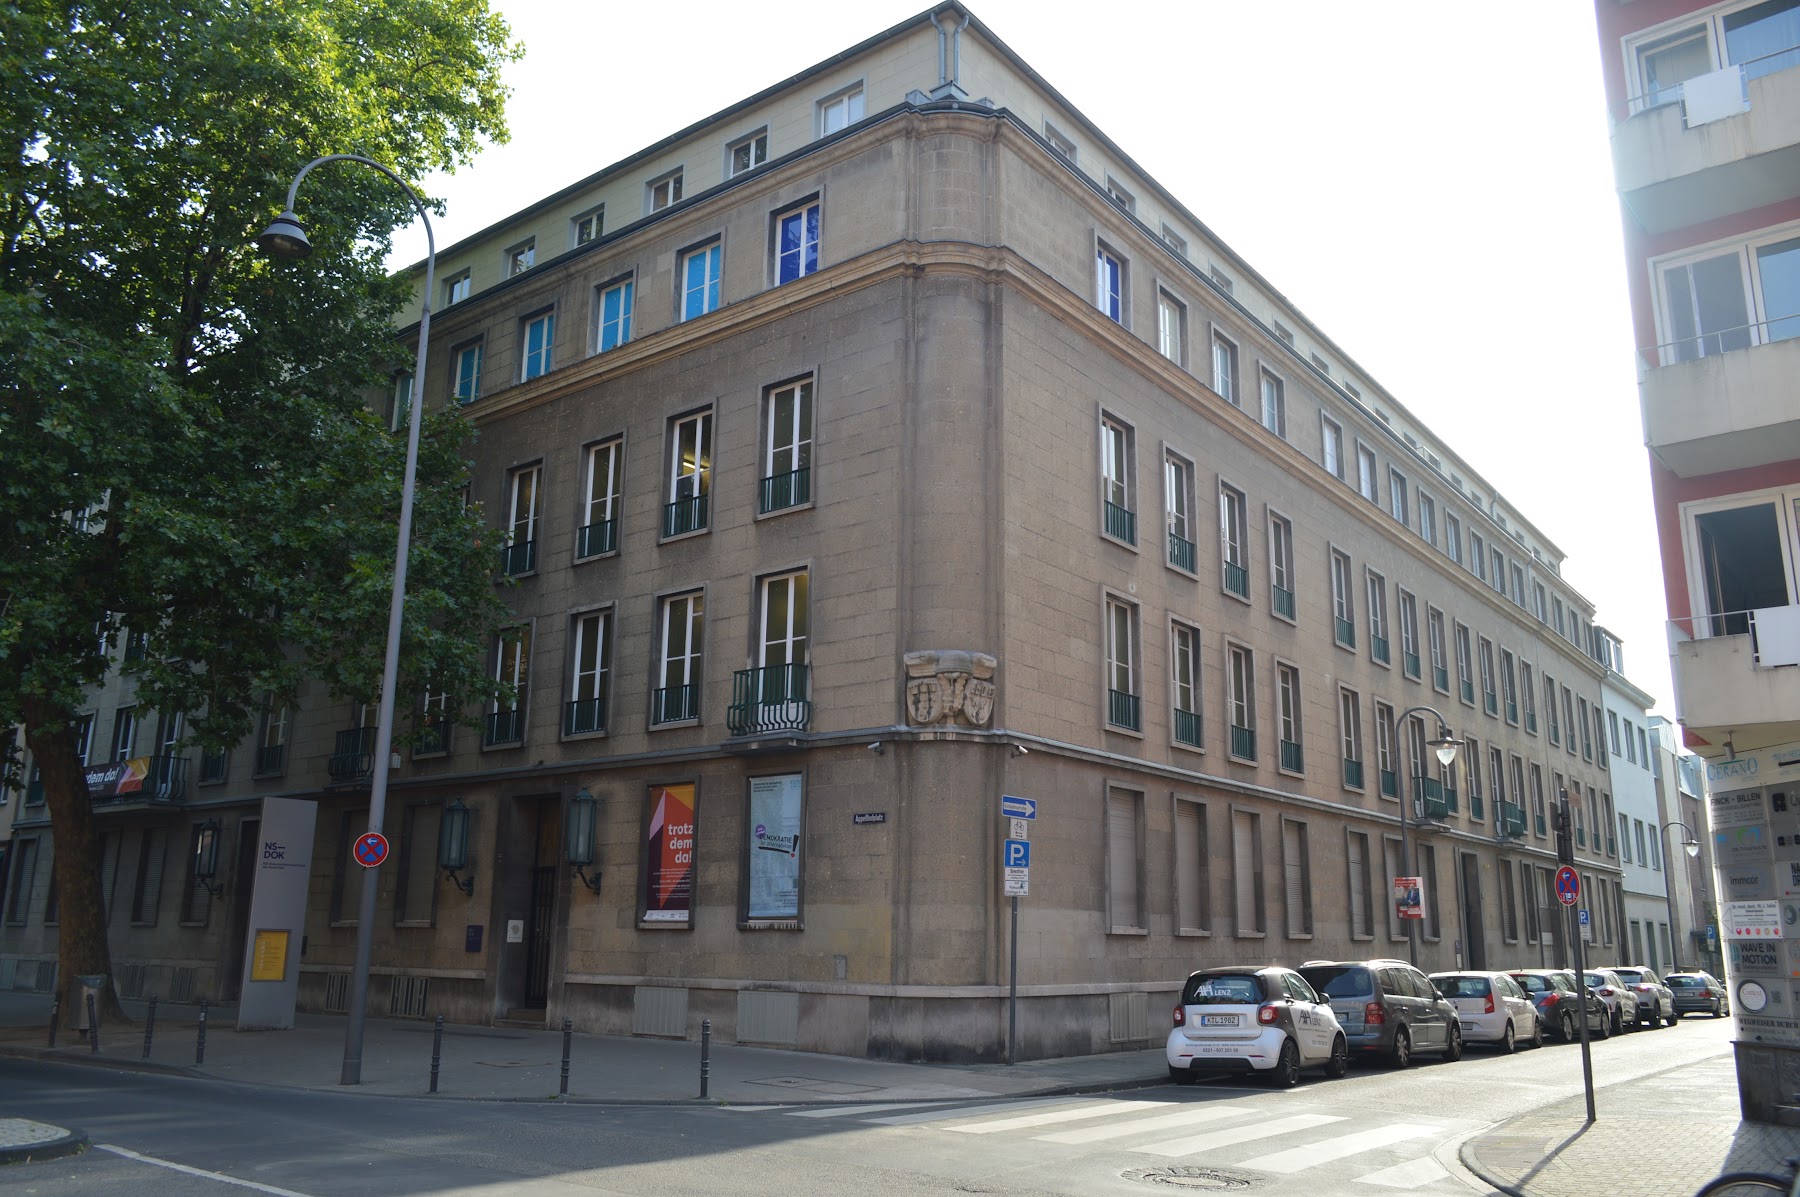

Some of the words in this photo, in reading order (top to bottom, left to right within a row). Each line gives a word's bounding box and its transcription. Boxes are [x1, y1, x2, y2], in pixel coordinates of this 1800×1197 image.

[1736, 793, 1761, 803] BILLEN
[668, 823, 693, 835] trotz
[669, 837, 693, 849] dem
[263, 851, 285, 860] DOK
[674, 850, 692, 864] da!
[1010, 843, 1025, 866] P
[1580, 911, 1587, 923] P
[1740, 943, 1764, 952] WAVE
[1766, 943, 1776, 952] IN
[1742, 954, 1777, 964] MOTION
[1194, 984, 1213, 997] AXA
[1739, 1018, 1775, 1027] WEGWEISER
[1776, 1020, 1799, 1029] DURCH
